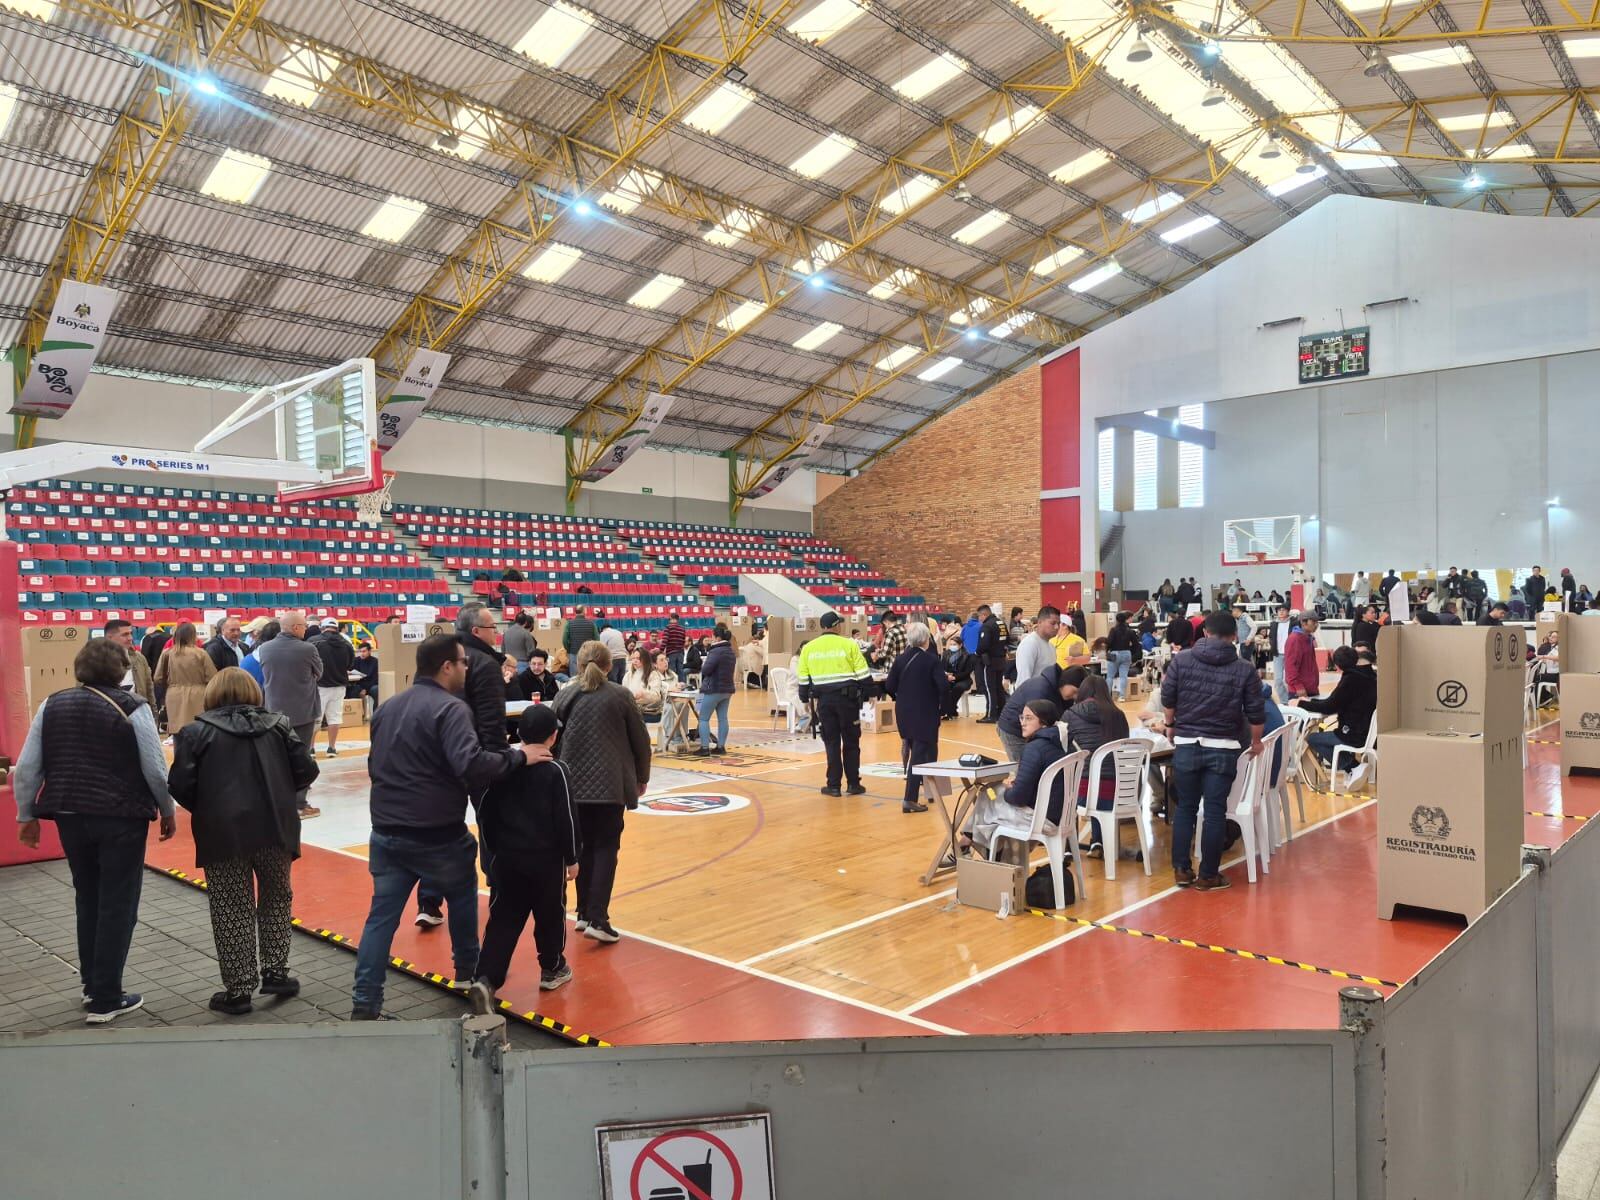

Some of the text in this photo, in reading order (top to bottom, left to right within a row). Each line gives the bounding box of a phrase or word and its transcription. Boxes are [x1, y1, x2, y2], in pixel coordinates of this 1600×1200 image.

[131, 457, 210, 471] PRO SERIES M1
[1386, 837, 1477, 856] REGISTRADURÍA
[1386, 845, 1417, 854] NACIONAL
[1432, 851, 1458, 859] ESTADO
[1459, 854, 1477, 862] CIVIL
